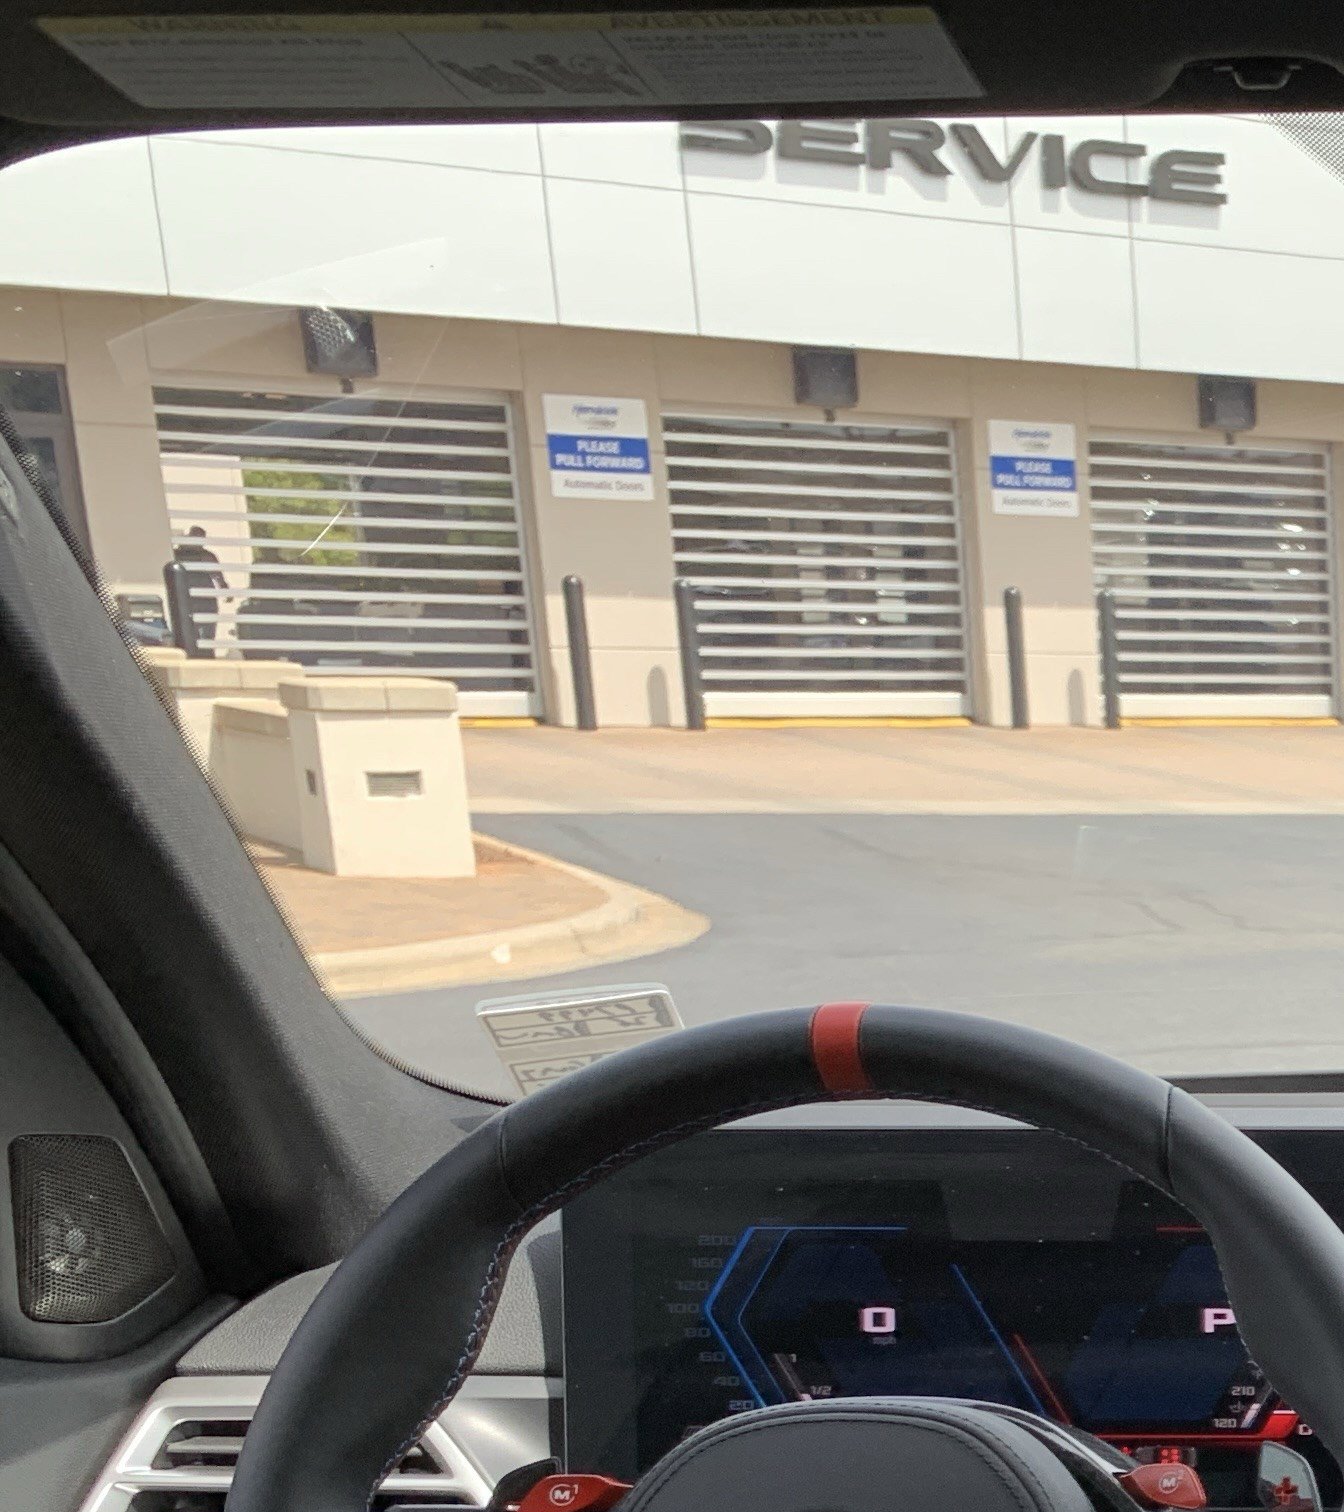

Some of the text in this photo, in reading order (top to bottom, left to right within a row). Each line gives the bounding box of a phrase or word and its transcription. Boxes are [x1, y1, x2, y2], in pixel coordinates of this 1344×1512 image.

[679, 118, 1228, 205] SERVICE
[576, 439, 620, 454] PLEASE
[555, 453, 646, 470] PULL FORWARD
[1014, 460, 1052, 474] PLEASE
[862, 1306, 896, 1333] 0
[1202, 1307, 1237, 1334] P
[1231, 1386, 1256, 1397] 210
[728, 1399, 755, 1411] 20
[1213, 1418, 1238, 1429] 120
